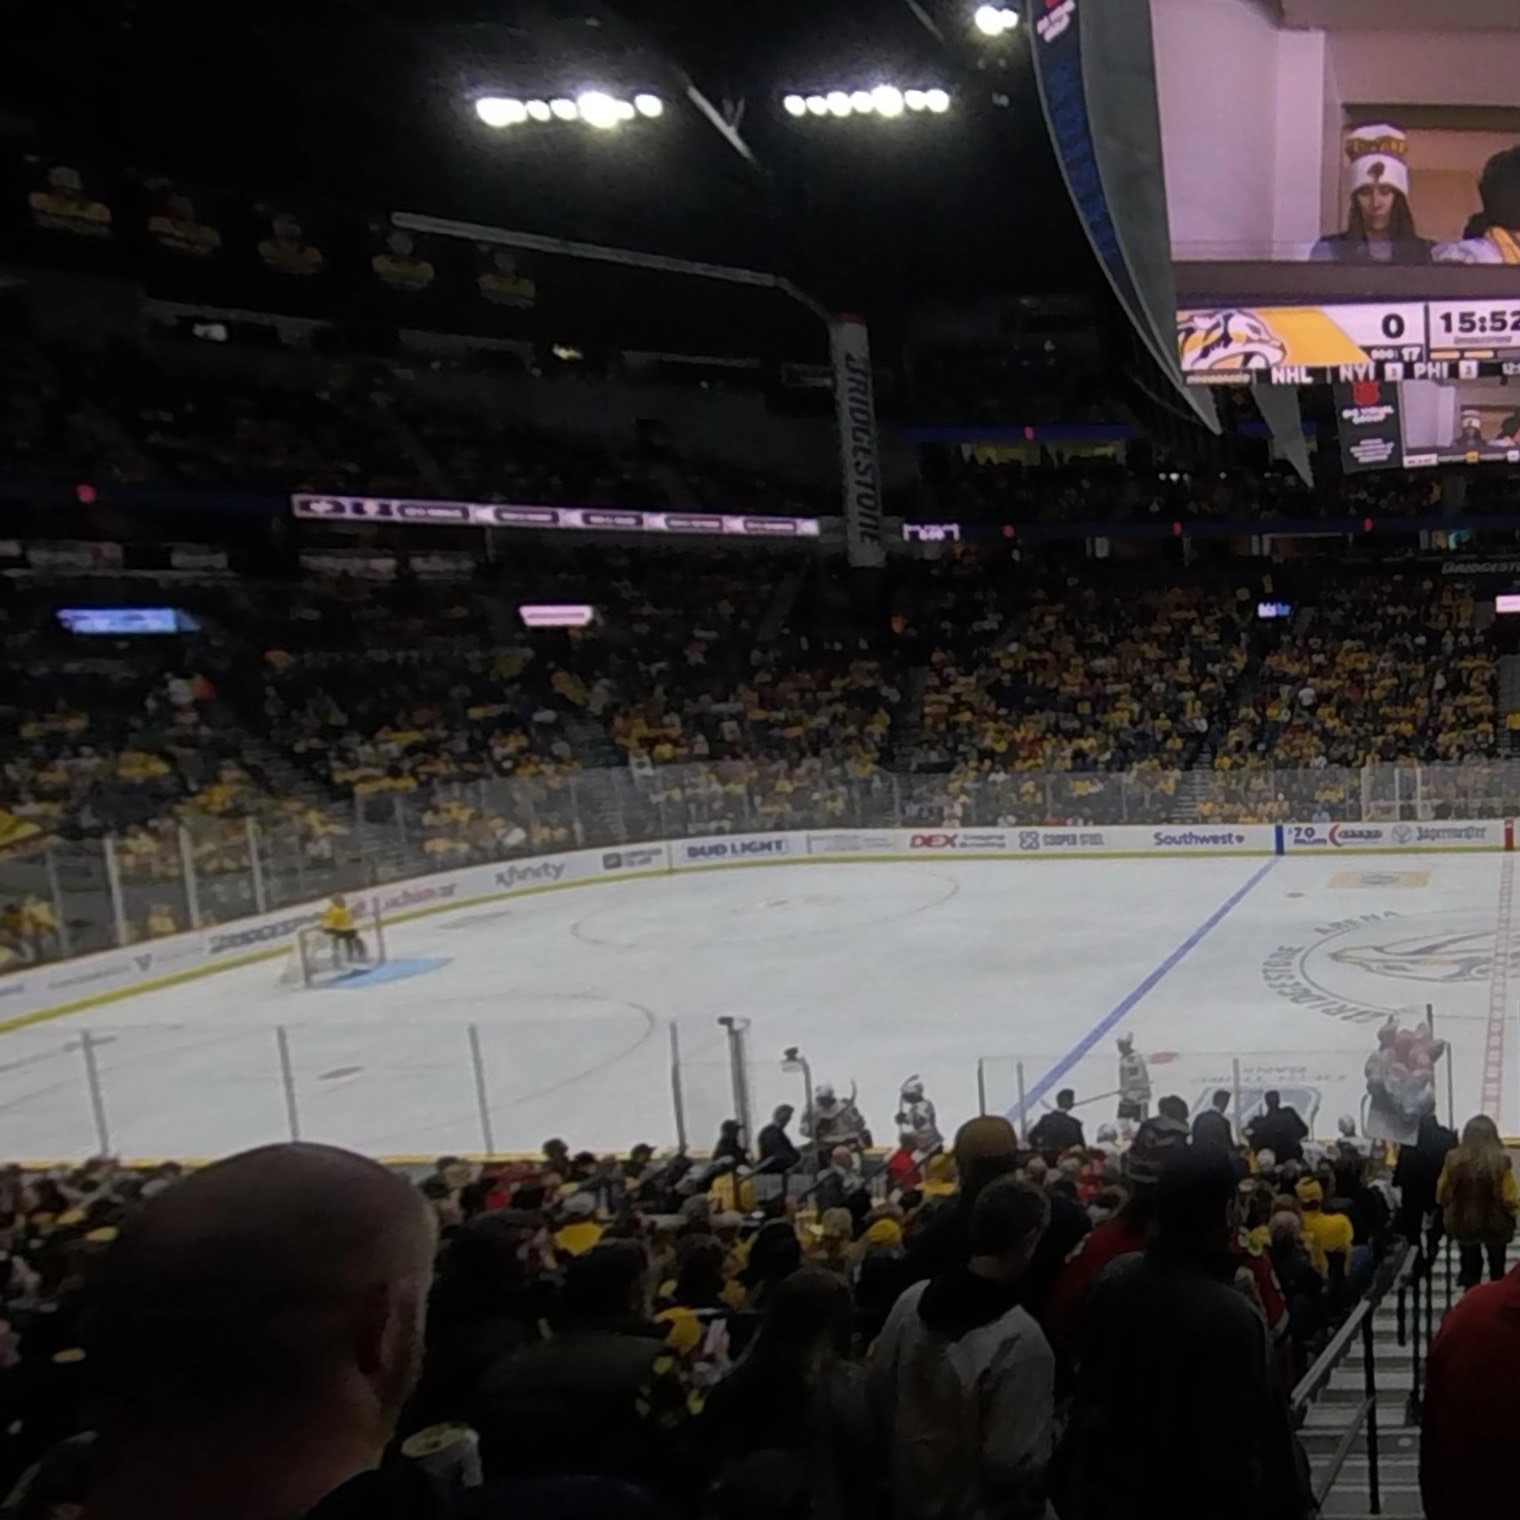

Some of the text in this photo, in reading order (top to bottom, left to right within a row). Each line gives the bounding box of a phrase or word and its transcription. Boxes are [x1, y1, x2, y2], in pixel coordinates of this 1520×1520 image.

[1382, 313, 1405, 338] 0
[1401, 347, 1421, 362] 17
[1271, 367, 1313, 384] NHL
[1340, 365, 1375, 381] NYI
[1414, 362, 1448, 380] PHI
[910, 834, 958, 848] DEX
[1154, 832, 1233, 846] Southwest
[687, 839, 784, 858] BUD LIGHT
[496, 862, 566, 889] xfinity
